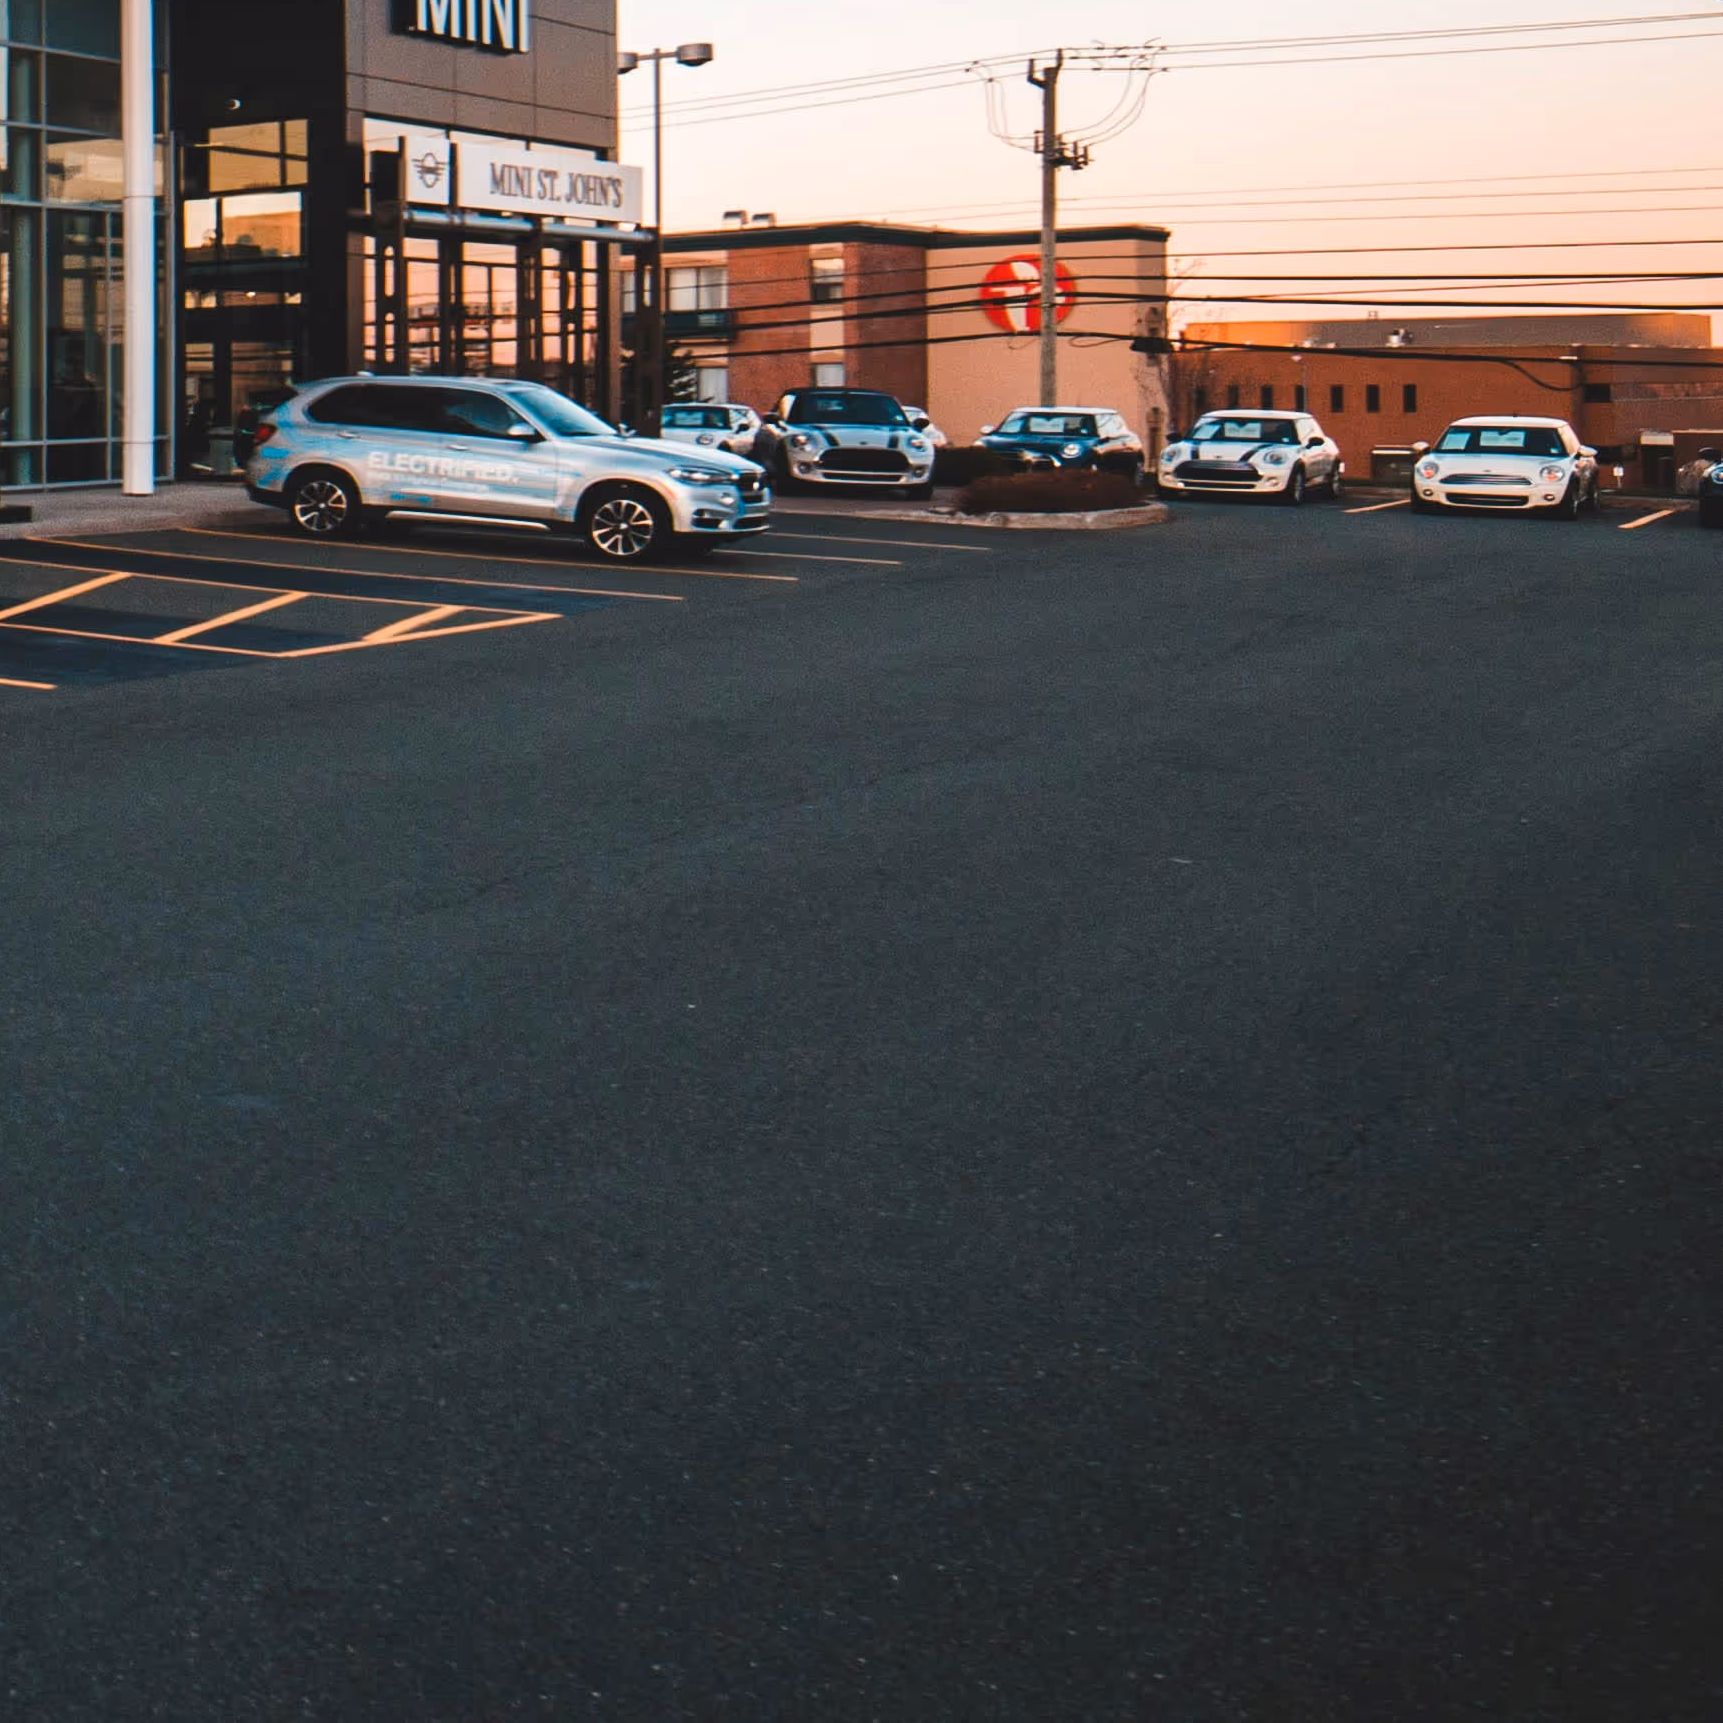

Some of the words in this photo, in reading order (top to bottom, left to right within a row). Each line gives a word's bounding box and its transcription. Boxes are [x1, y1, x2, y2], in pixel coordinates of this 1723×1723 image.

[489, 162, 533, 199] MINI
[537, 168, 562, 202] ST.
[566, 172, 623, 208] JOHN'S
